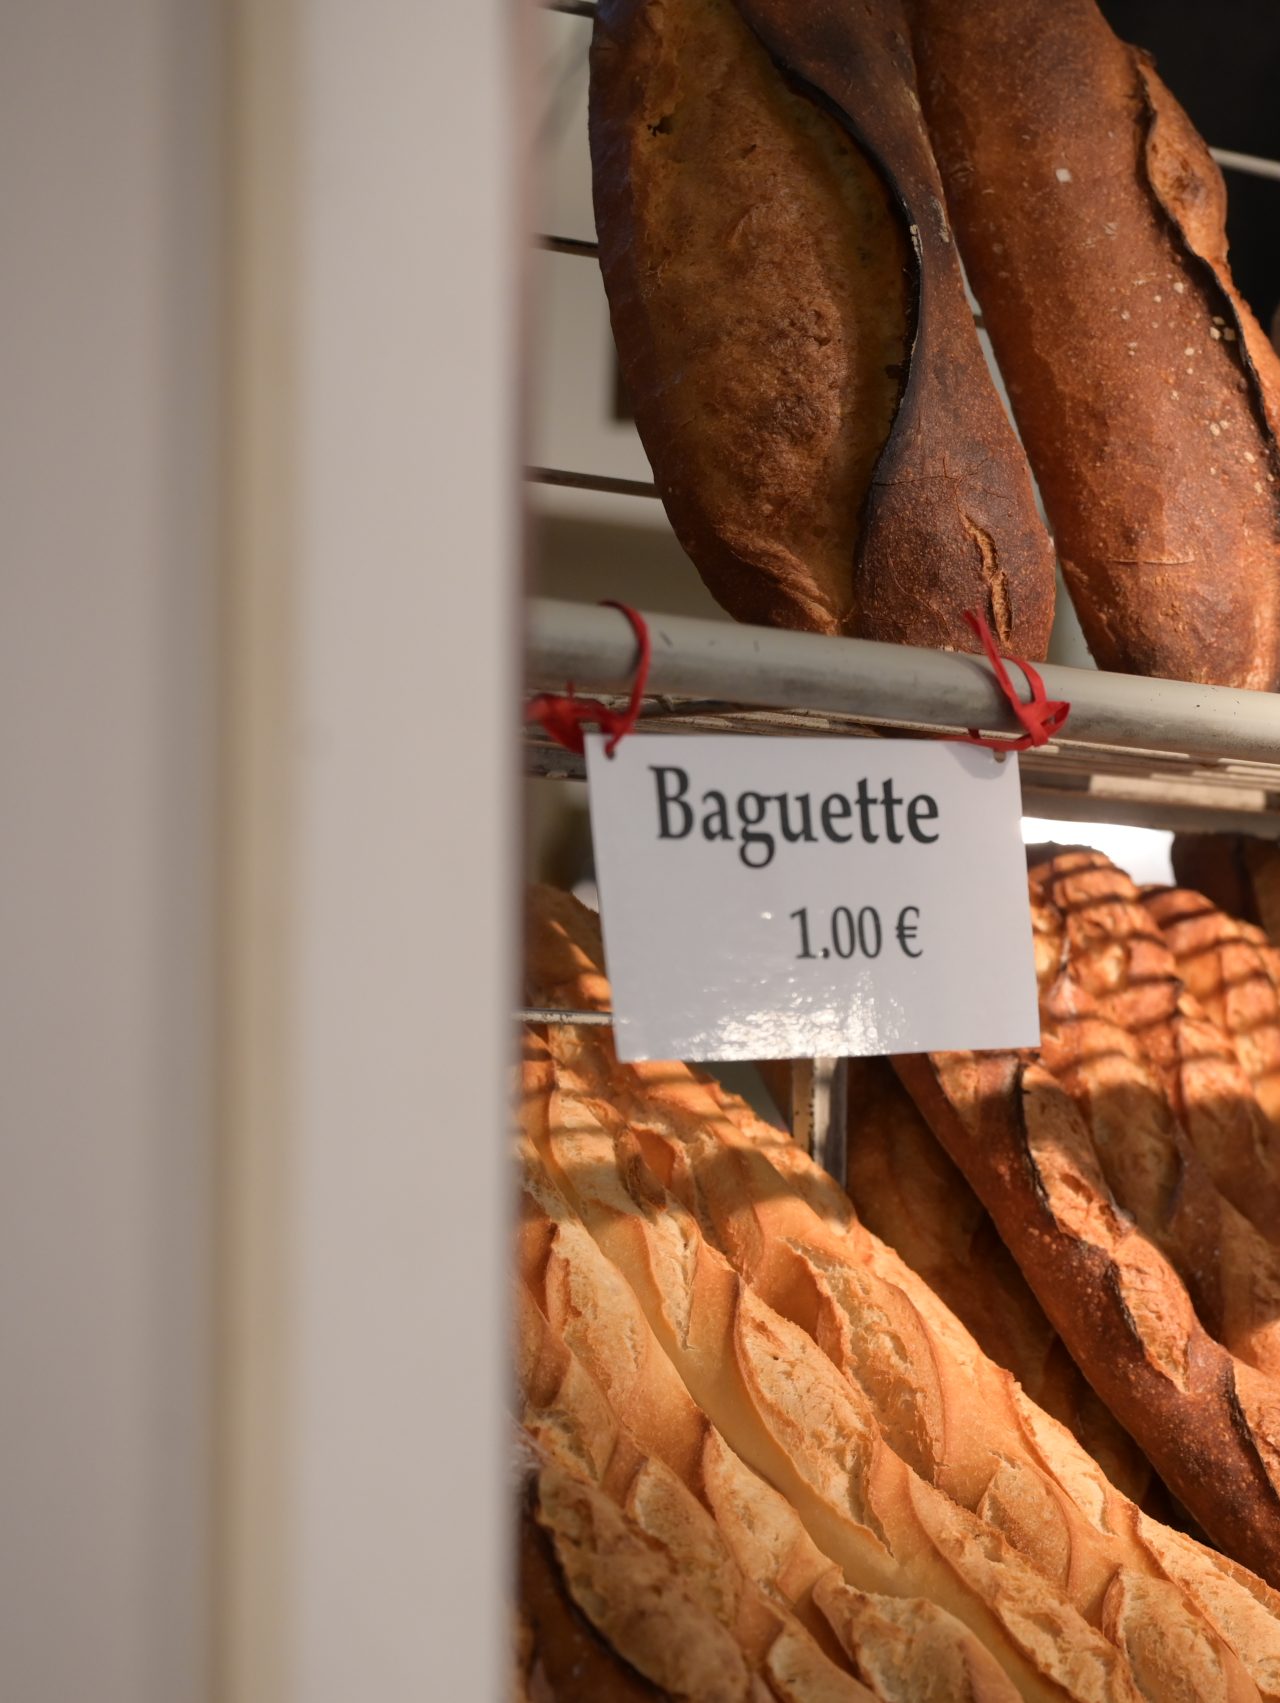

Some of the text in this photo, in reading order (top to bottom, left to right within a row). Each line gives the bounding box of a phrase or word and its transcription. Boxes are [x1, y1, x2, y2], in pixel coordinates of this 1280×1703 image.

[648, 766, 940, 868] Baguette
[789, 906, 923, 959] 1.00 €
